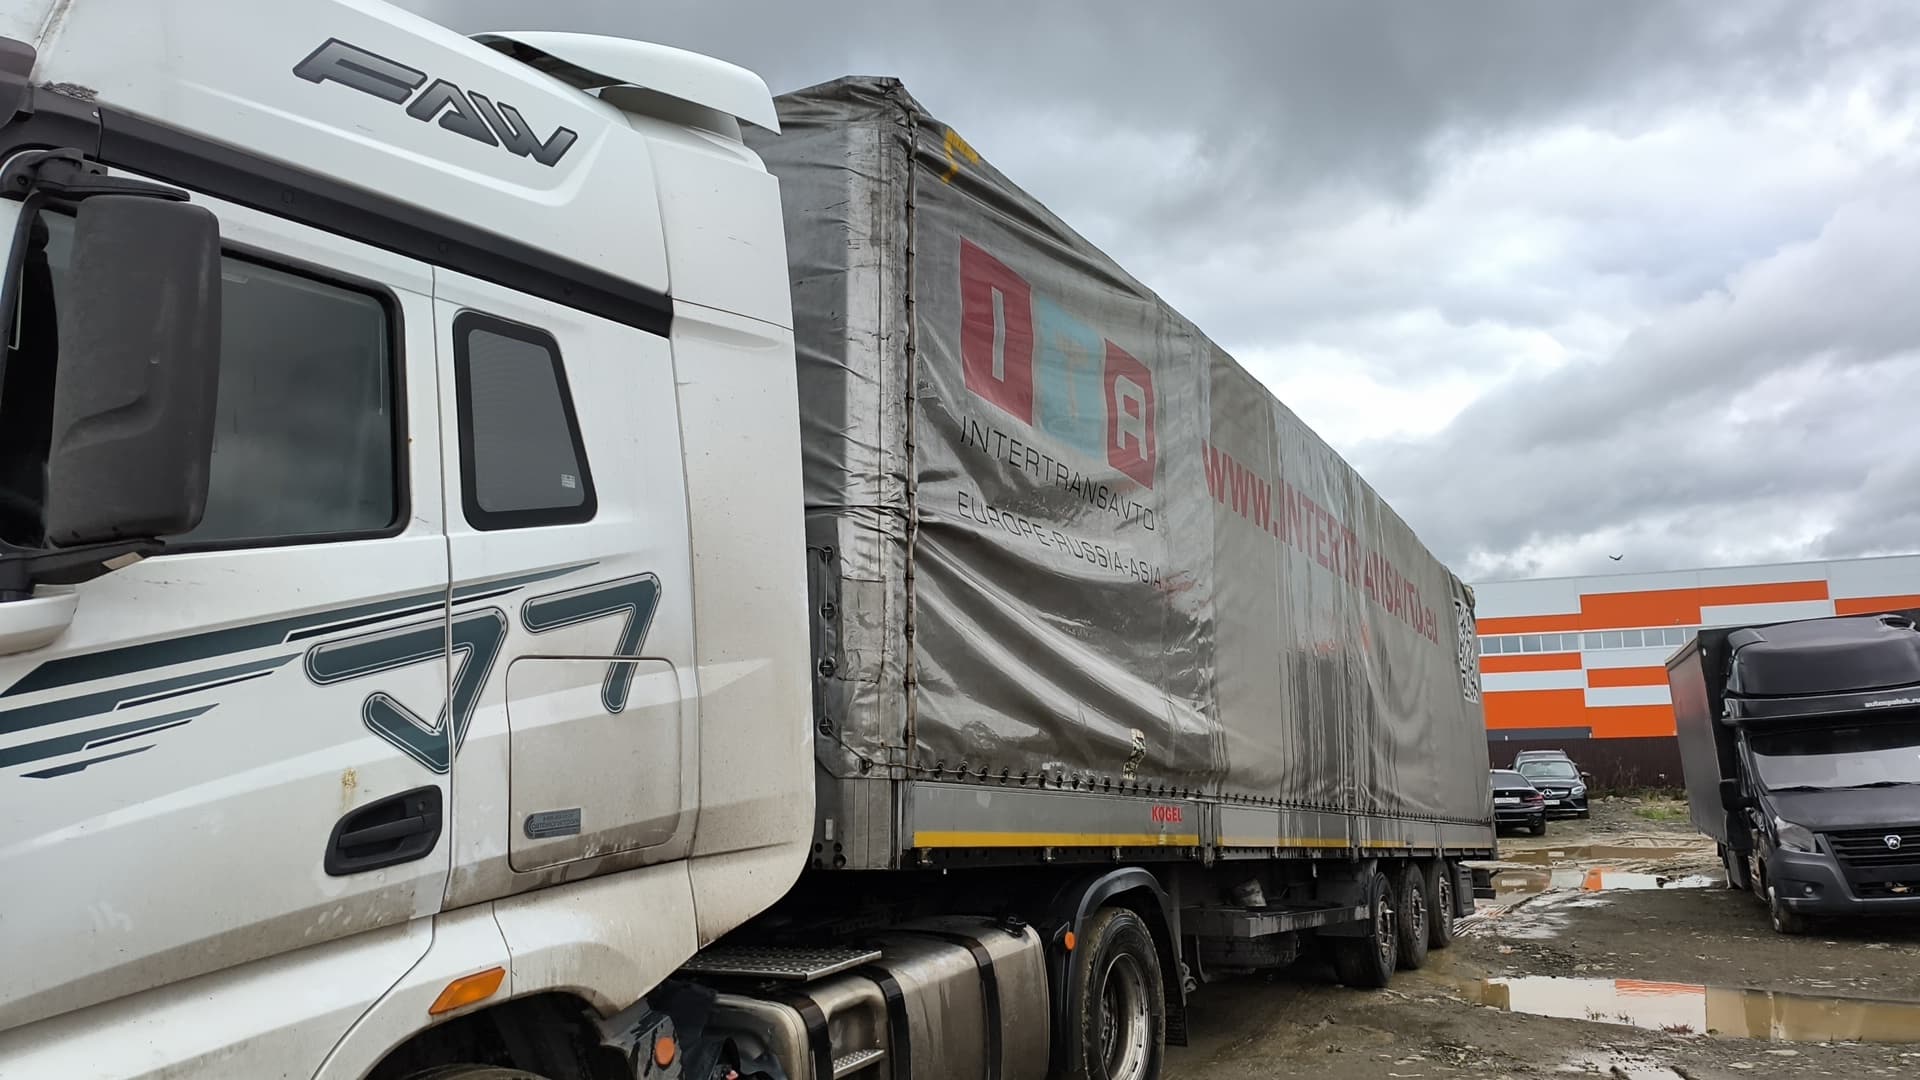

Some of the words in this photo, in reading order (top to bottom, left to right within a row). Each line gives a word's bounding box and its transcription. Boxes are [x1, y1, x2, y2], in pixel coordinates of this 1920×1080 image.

[292, 37, 578, 167] FAW
[959, 415, 1156, 531] INTERTRANSAVTO
[958, 490, 1162, 588] EUROPE-RUSSIA-ASIA
